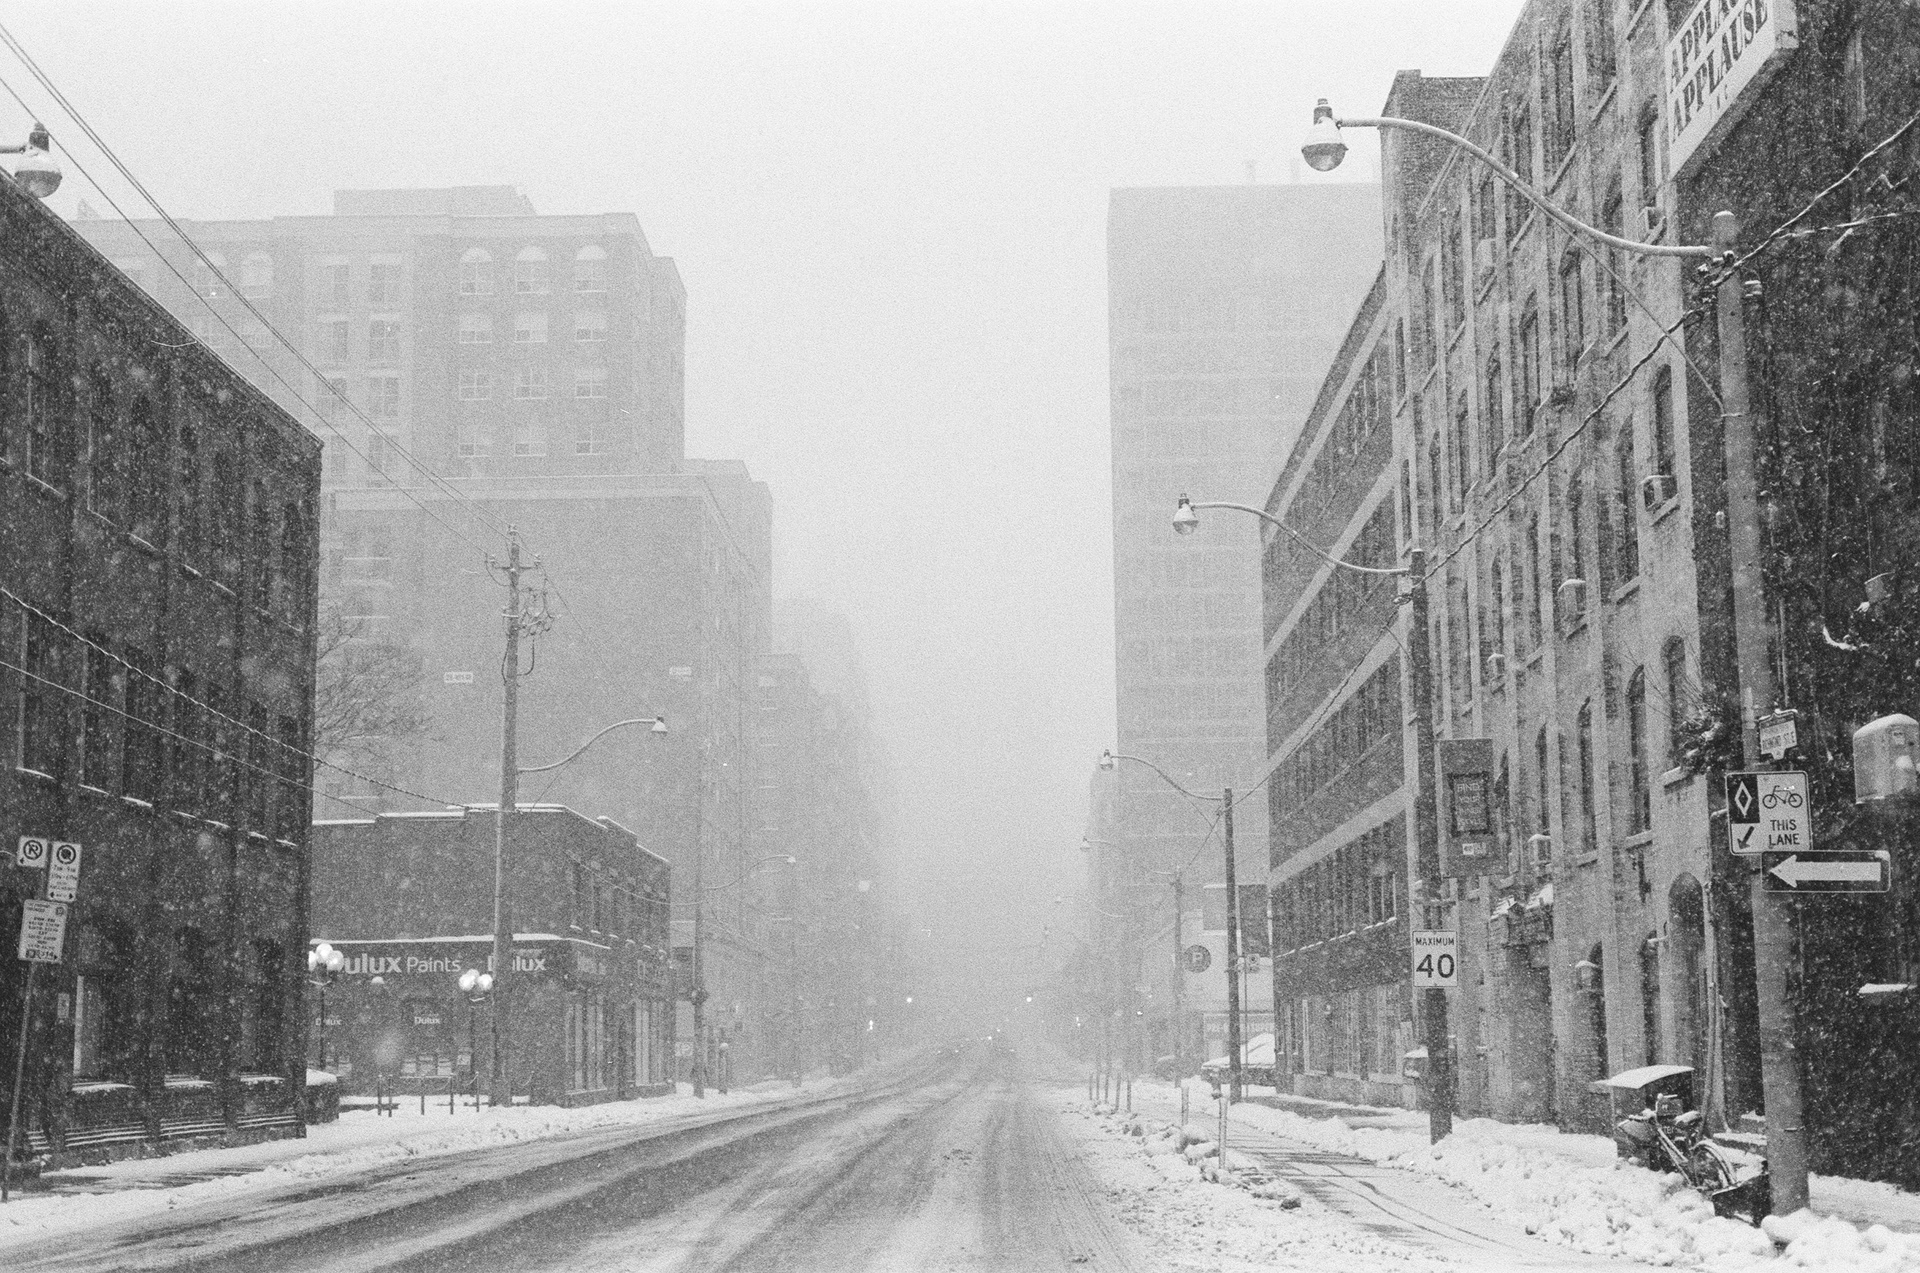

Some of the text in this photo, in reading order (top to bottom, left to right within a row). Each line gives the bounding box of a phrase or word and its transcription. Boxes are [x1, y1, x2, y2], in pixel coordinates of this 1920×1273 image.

[1670, 0, 1738, 94] APPLA
[1671, 0, 1768, 144] APPLAUSE
[1770, 819, 1797, 831] THIS
[1768, 833, 1800, 846] LANE
[1415, 936, 1455, 947] MAXIMUM
[343, 953, 461, 974] ulux Paints
[1416, 953, 1455, 978] 40
[414, 1016, 441, 1026] Dulux
